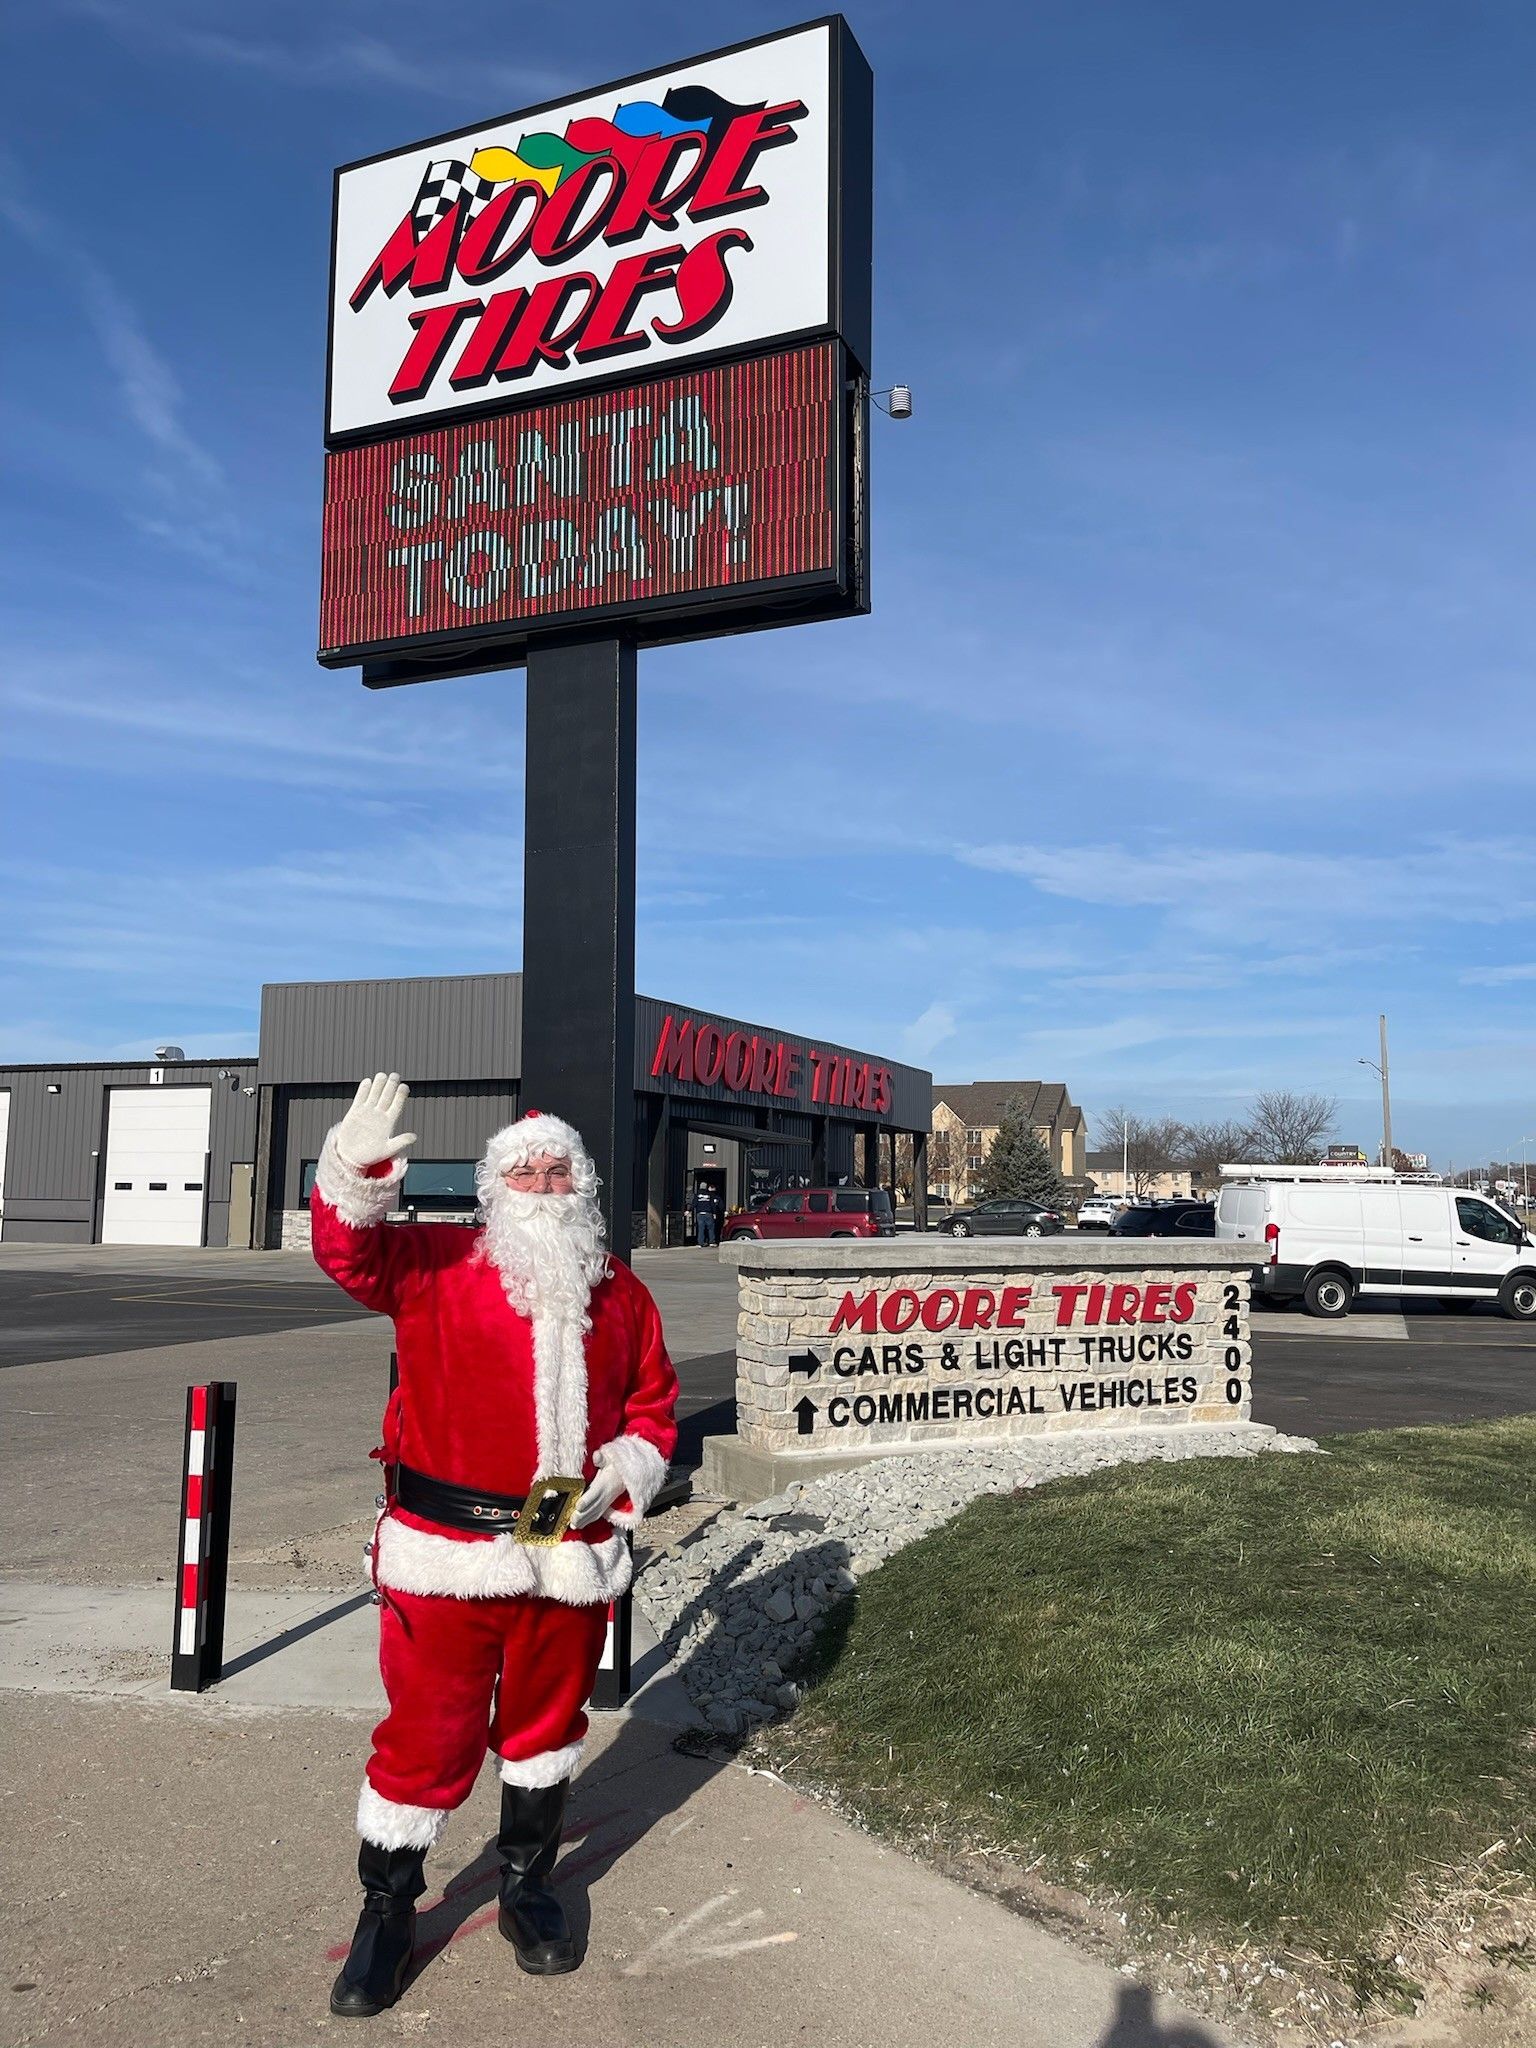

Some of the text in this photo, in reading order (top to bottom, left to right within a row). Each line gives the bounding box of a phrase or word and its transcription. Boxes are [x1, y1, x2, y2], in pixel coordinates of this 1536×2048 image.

[349, 99, 809, 312] MOORE
[387, 228, 754, 405] TIRES
[387, 395, 718, 530] SANTA
[388, 483, 748, 617] TODAY!
[651, 1015, 893, 1114] MOORE TIRES
[828, 1282, 1197, 1334] MOORE TIRES
[833, 1333, 1193, 1377] CARS & LIGHT TRUCKS
[828, 1377, 1198, 1427] COMMERCIAL VEHICLES
